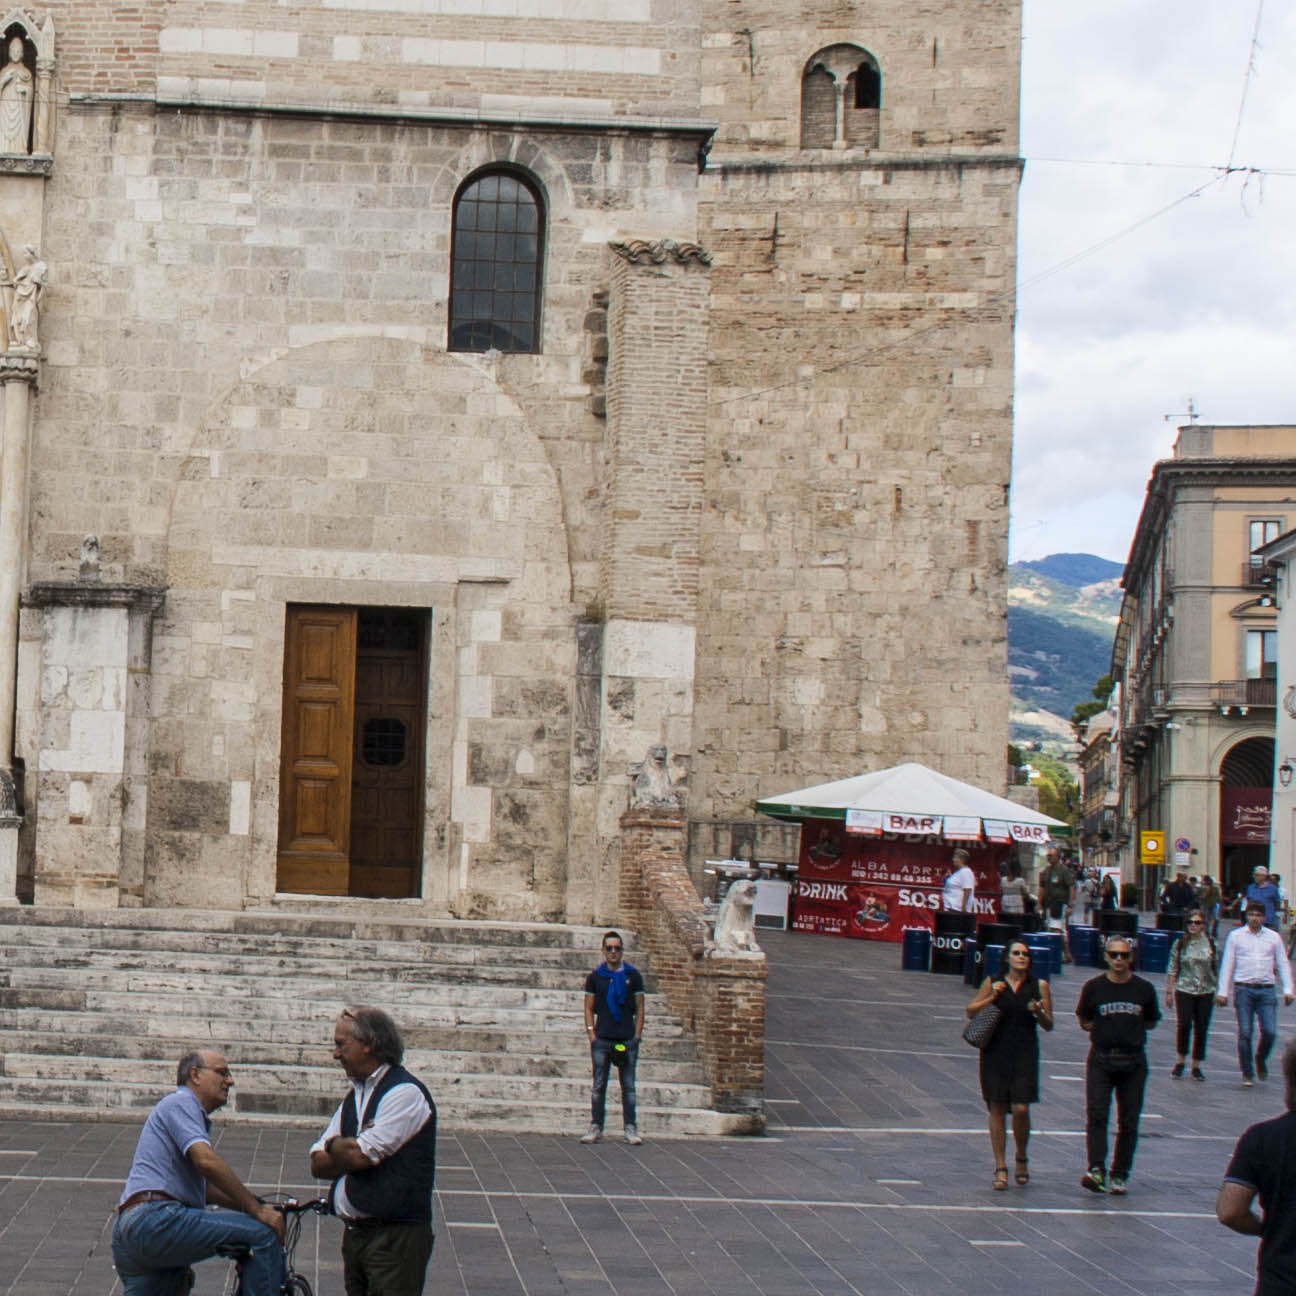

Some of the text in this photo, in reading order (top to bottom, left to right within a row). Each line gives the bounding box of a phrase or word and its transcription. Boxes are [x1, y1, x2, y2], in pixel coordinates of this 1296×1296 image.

[890, 815, 934, 830] BAR
[1012, 824, 1044, 841] BAR
[851, 859, 888, 872] ALBA
[799, 882, 848, 901] DRINK
